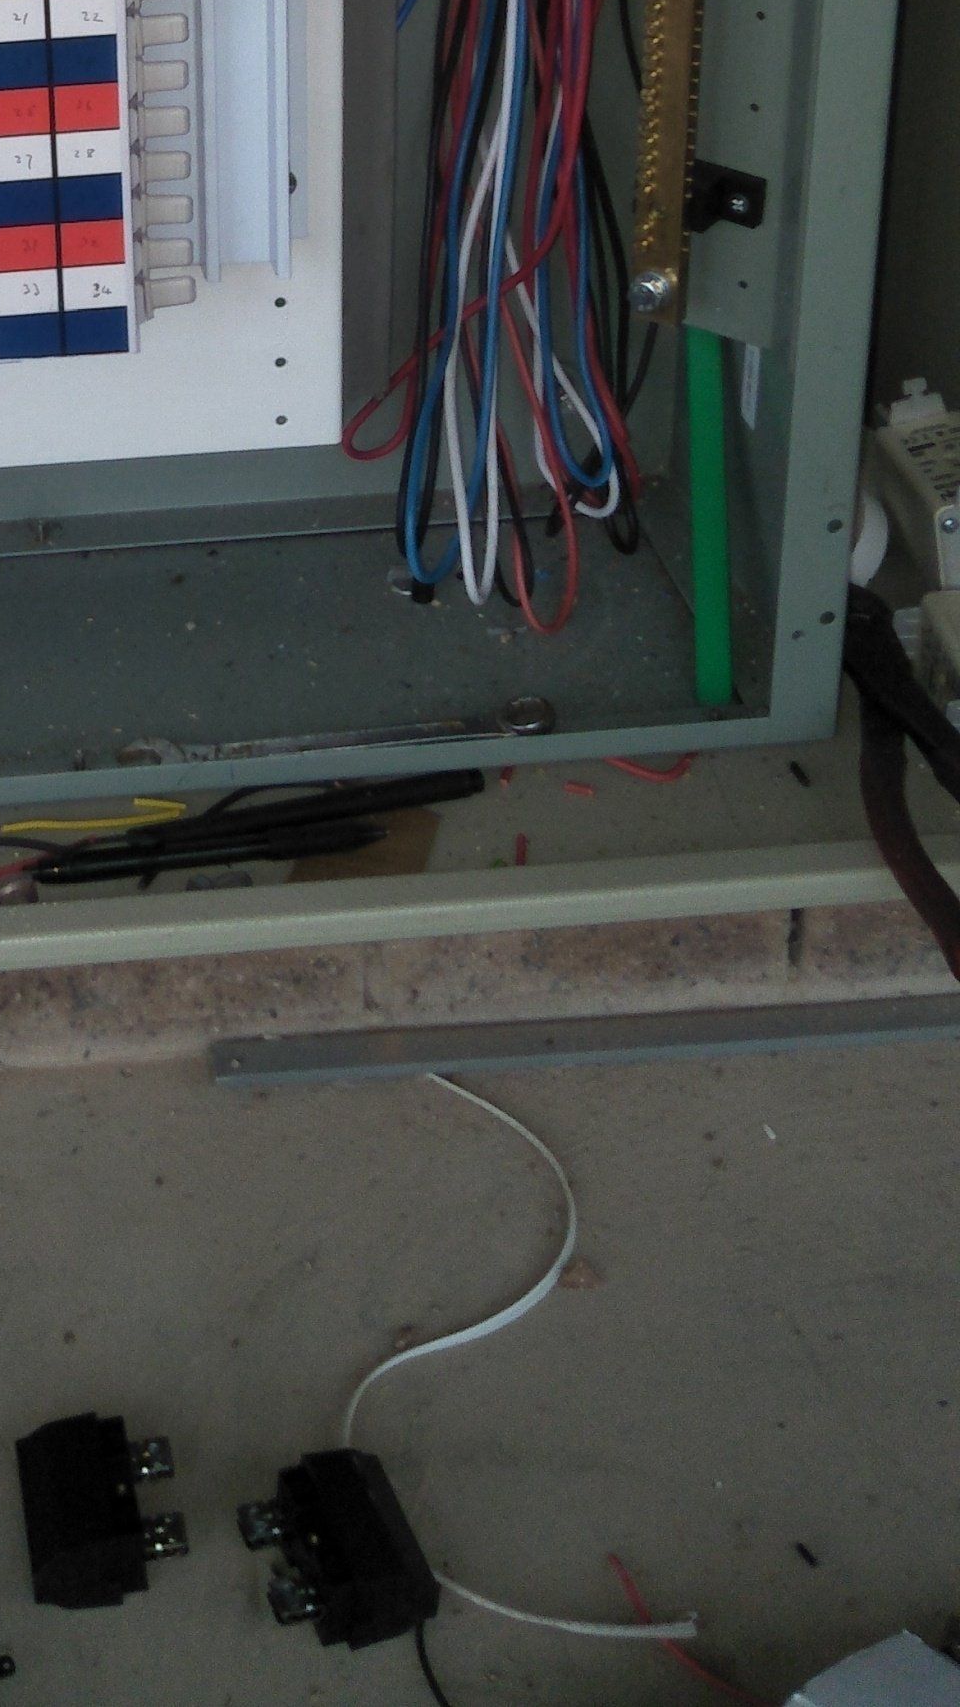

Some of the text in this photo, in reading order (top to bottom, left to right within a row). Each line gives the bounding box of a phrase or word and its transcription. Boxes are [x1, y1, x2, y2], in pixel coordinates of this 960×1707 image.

[13, 12, 29, 25] 21
[82, 10, 104, 22] 22
[74, 148, 96, 158] 28
[14, 154, 33, 170] 27
[23, 284, 40, 296] 33
